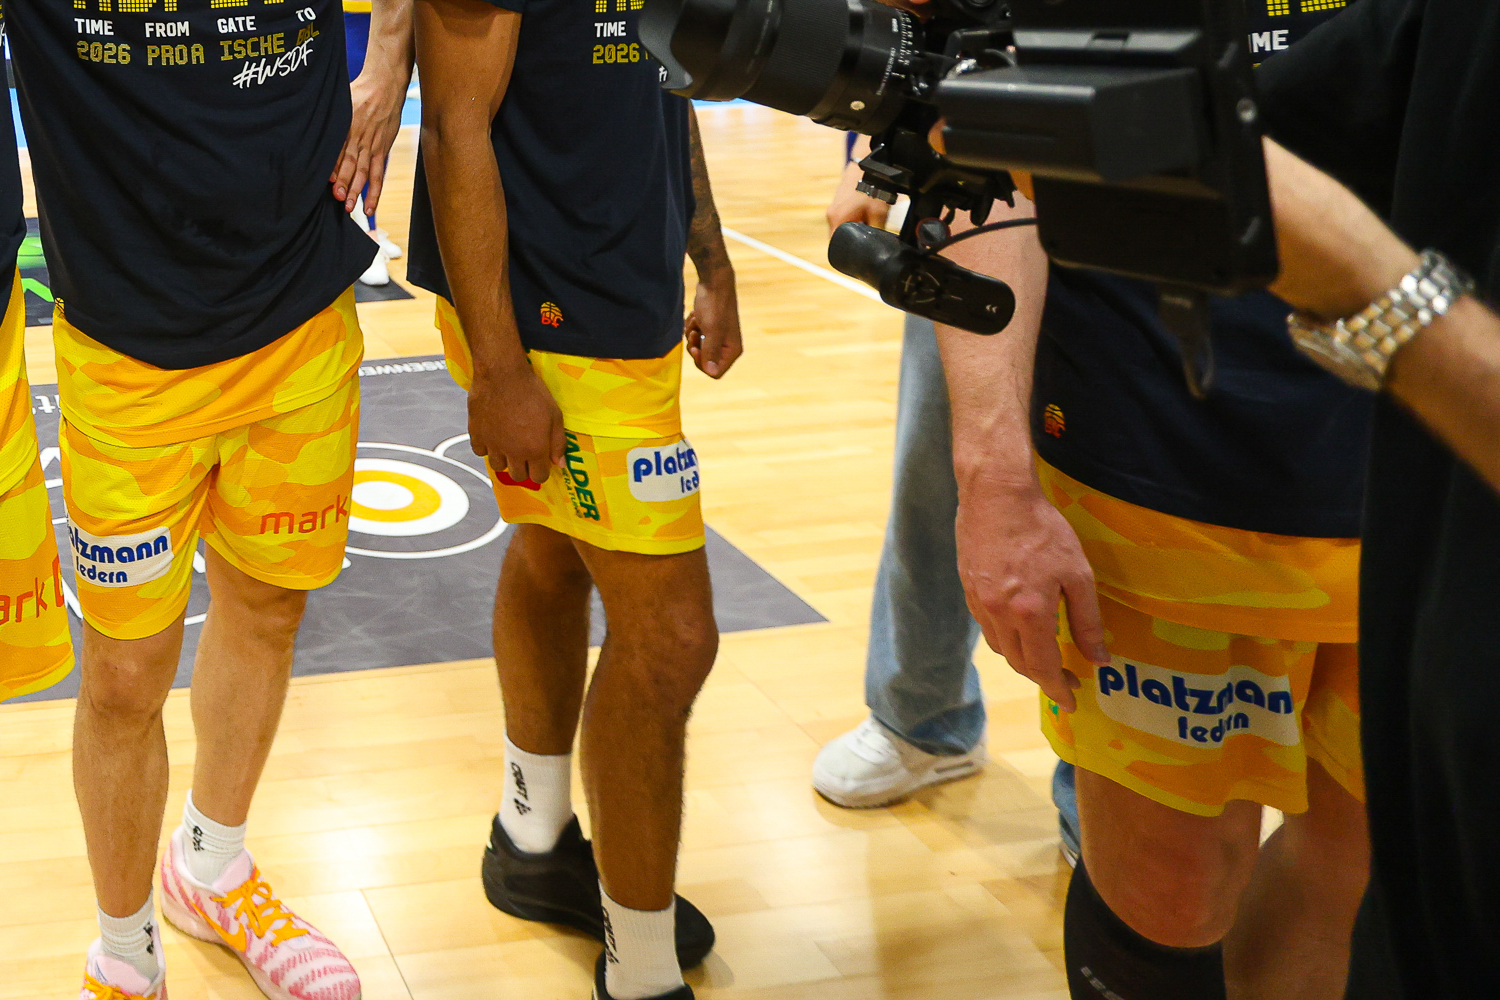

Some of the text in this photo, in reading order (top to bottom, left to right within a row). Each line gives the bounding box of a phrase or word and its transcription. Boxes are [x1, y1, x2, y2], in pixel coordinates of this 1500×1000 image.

[74, 7, 317, 38] TIME FROM GATE TO
[594, 21, 627, 38] TIME
[76, 40, 132, 65] 2026
[219, 32, 286, 61] ISCHE
[592, 43, 640, 65] 2026
[259, 494, 348, 535] mark
